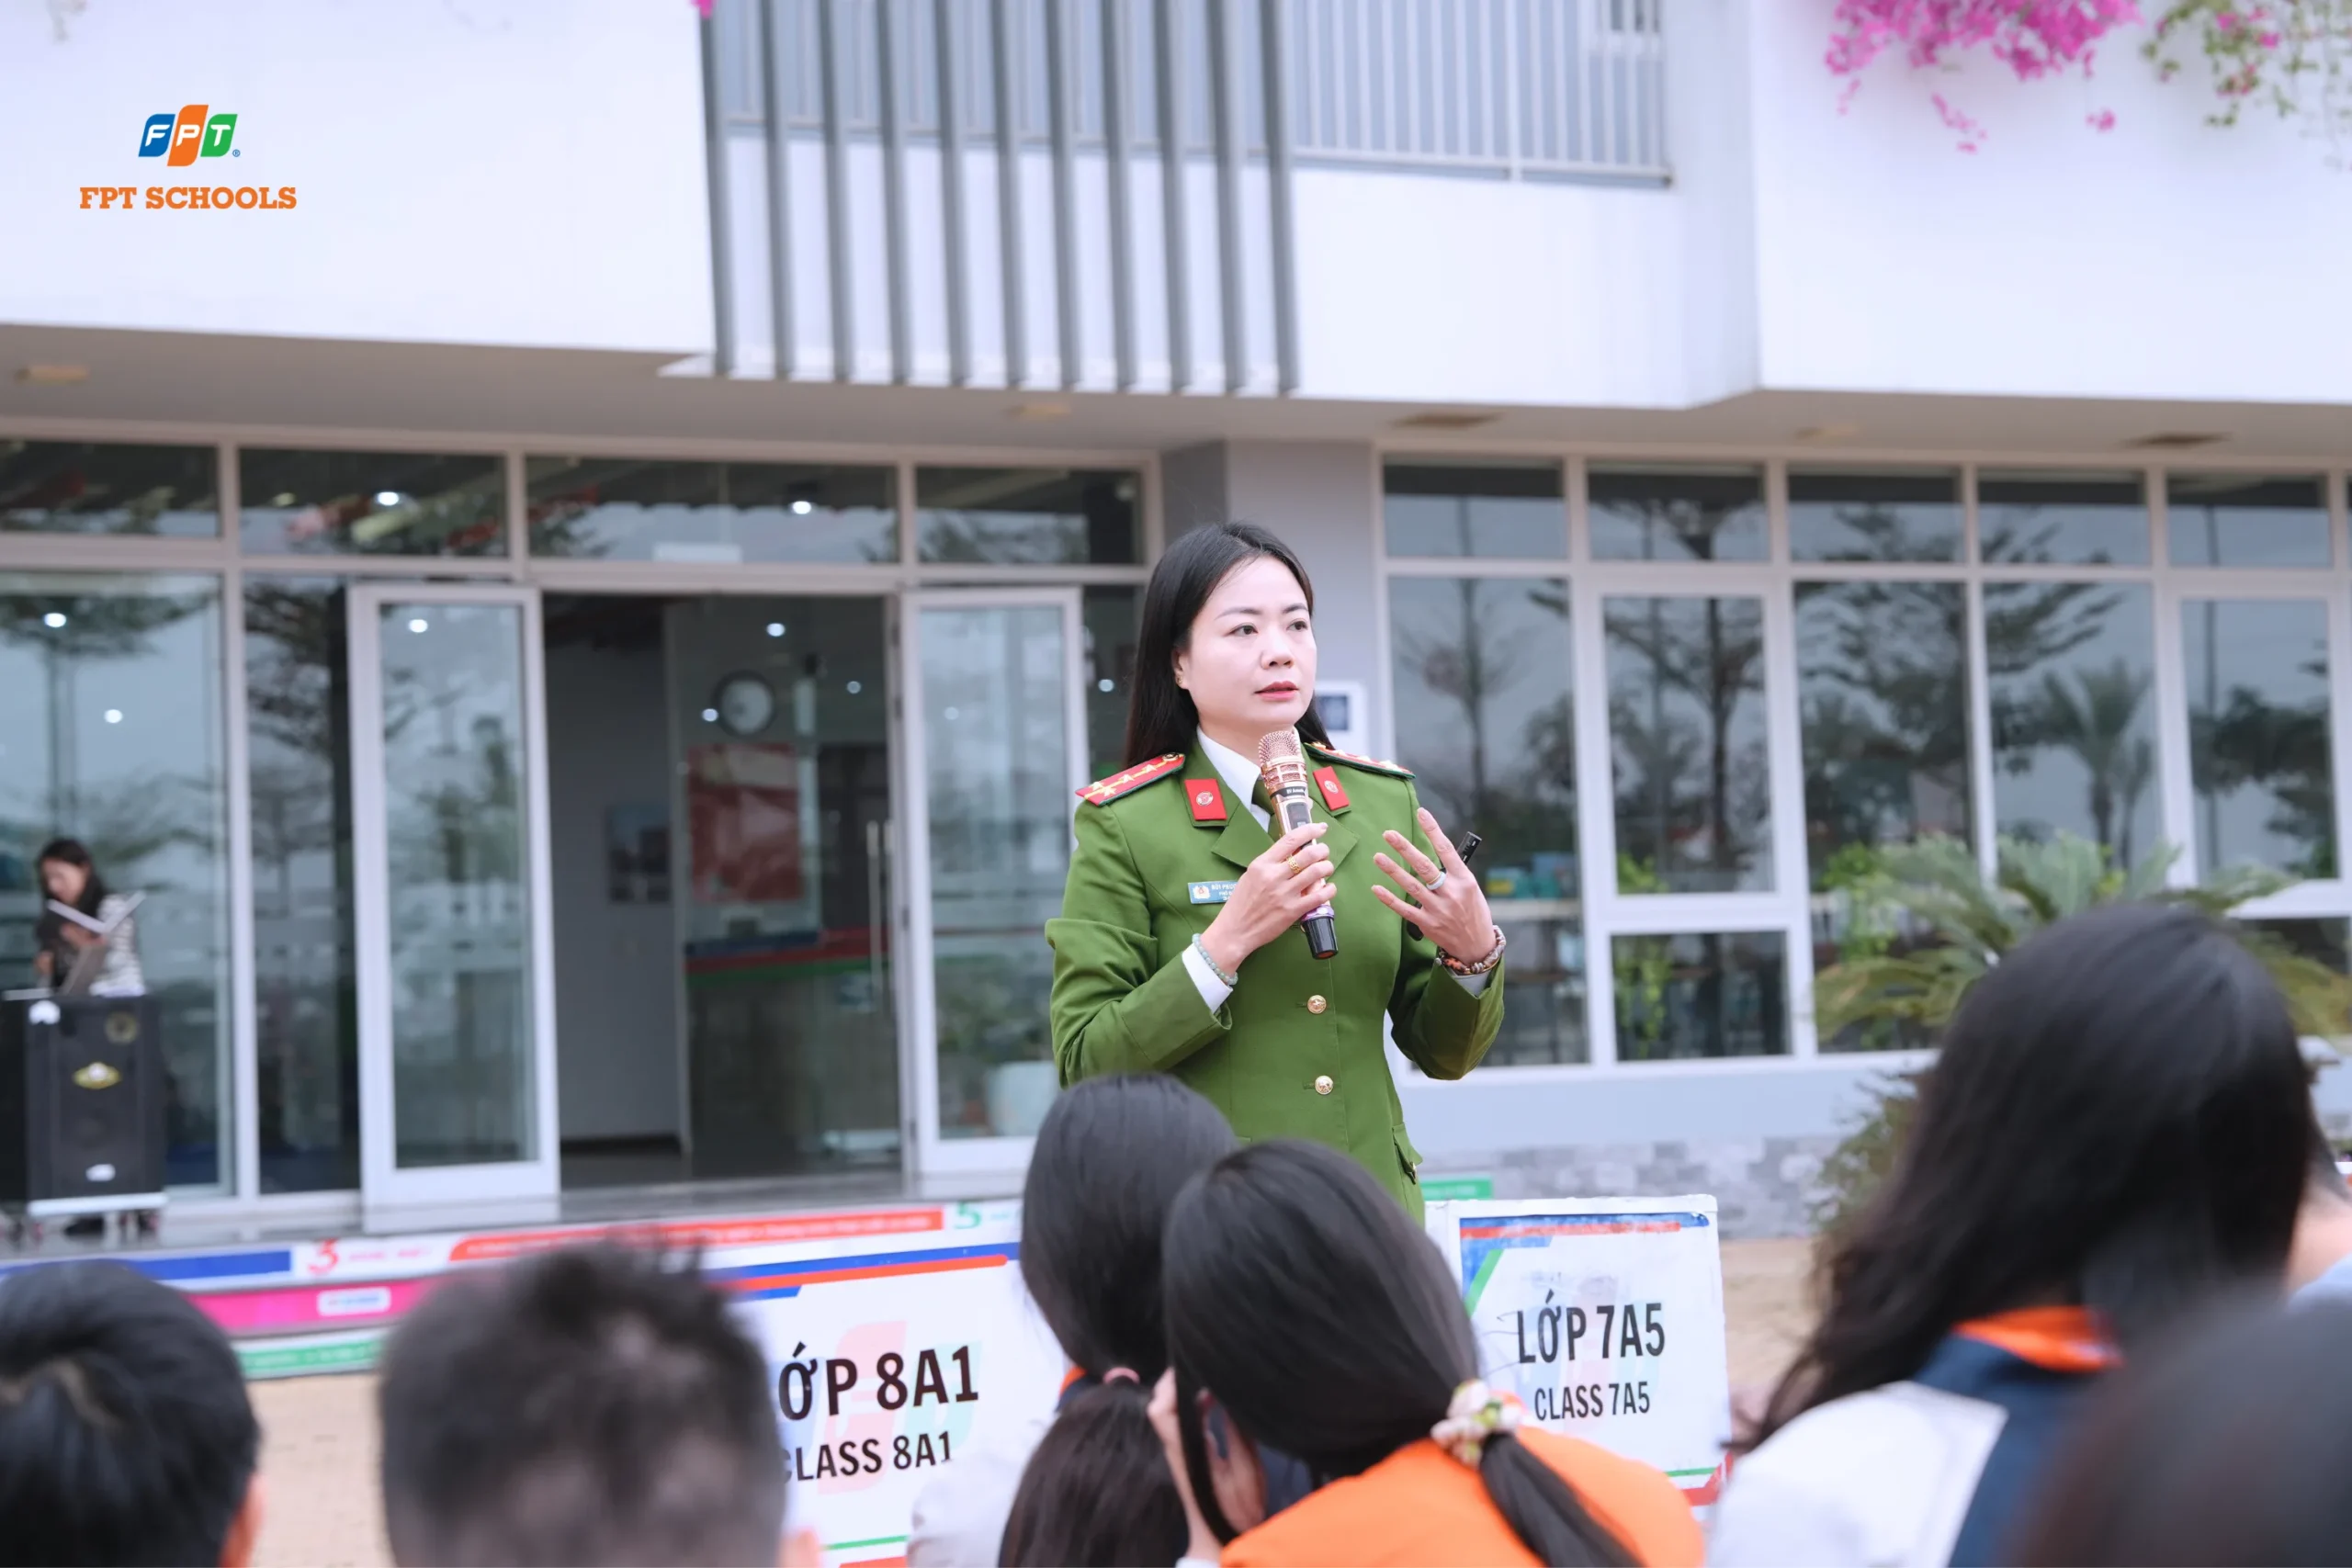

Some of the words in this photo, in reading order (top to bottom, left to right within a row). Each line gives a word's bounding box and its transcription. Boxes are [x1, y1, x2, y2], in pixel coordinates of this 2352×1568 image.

[1516, 1288, 1588, 1364] LỚP
[1596, 1303, 1666, 1360] 7A5
[777, 1340, 859, 1422] ỚP
[875, 1345, 980, 1412] 8A1
[1534, 1382, 1604, 1421] CLASS
[1608, 1381, 1651, 1416] 7A5
[893, 1431, 953, 1470] 8A1
